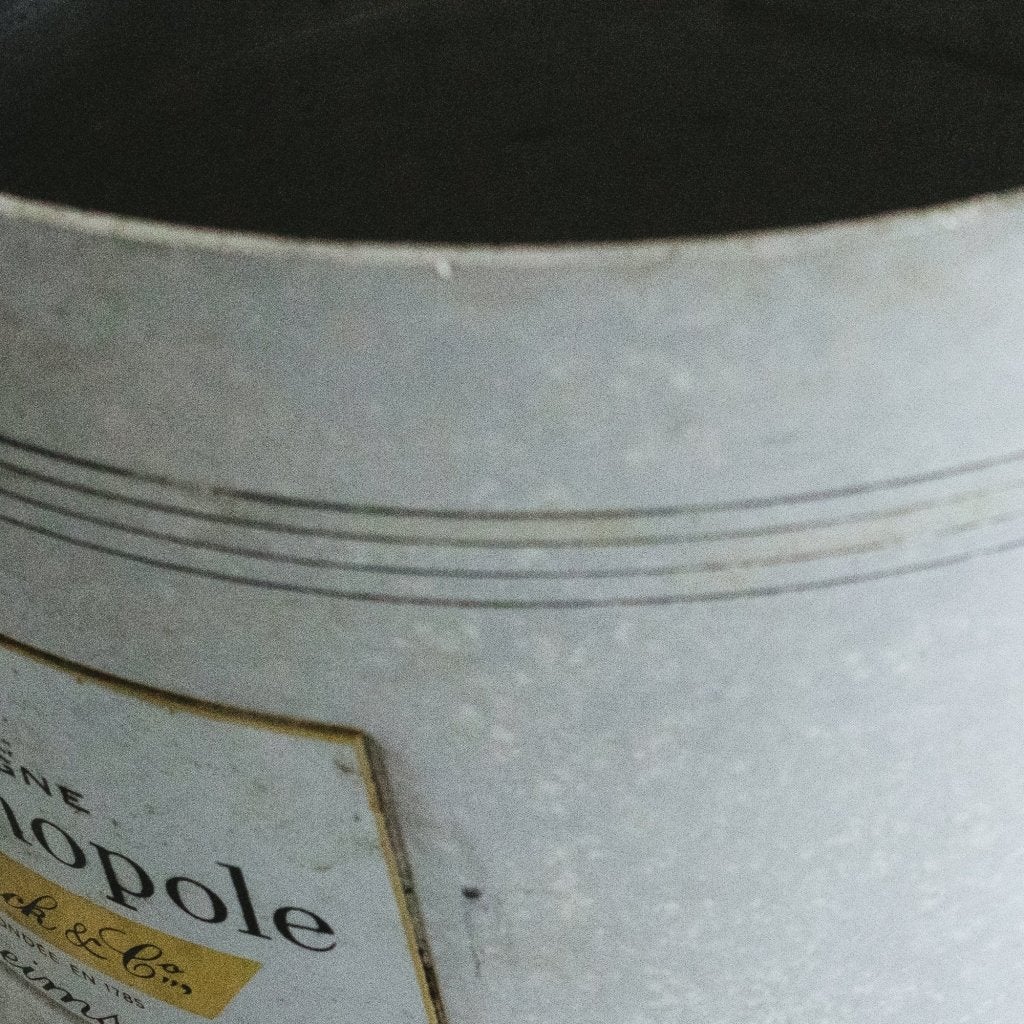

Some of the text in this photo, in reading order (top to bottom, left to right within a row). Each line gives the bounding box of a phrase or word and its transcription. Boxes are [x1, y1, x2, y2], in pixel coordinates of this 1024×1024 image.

[65, 922, 108, 960] &
[70, 963, 97, 985] EN
[104, 982, 146, 1010] 1785
